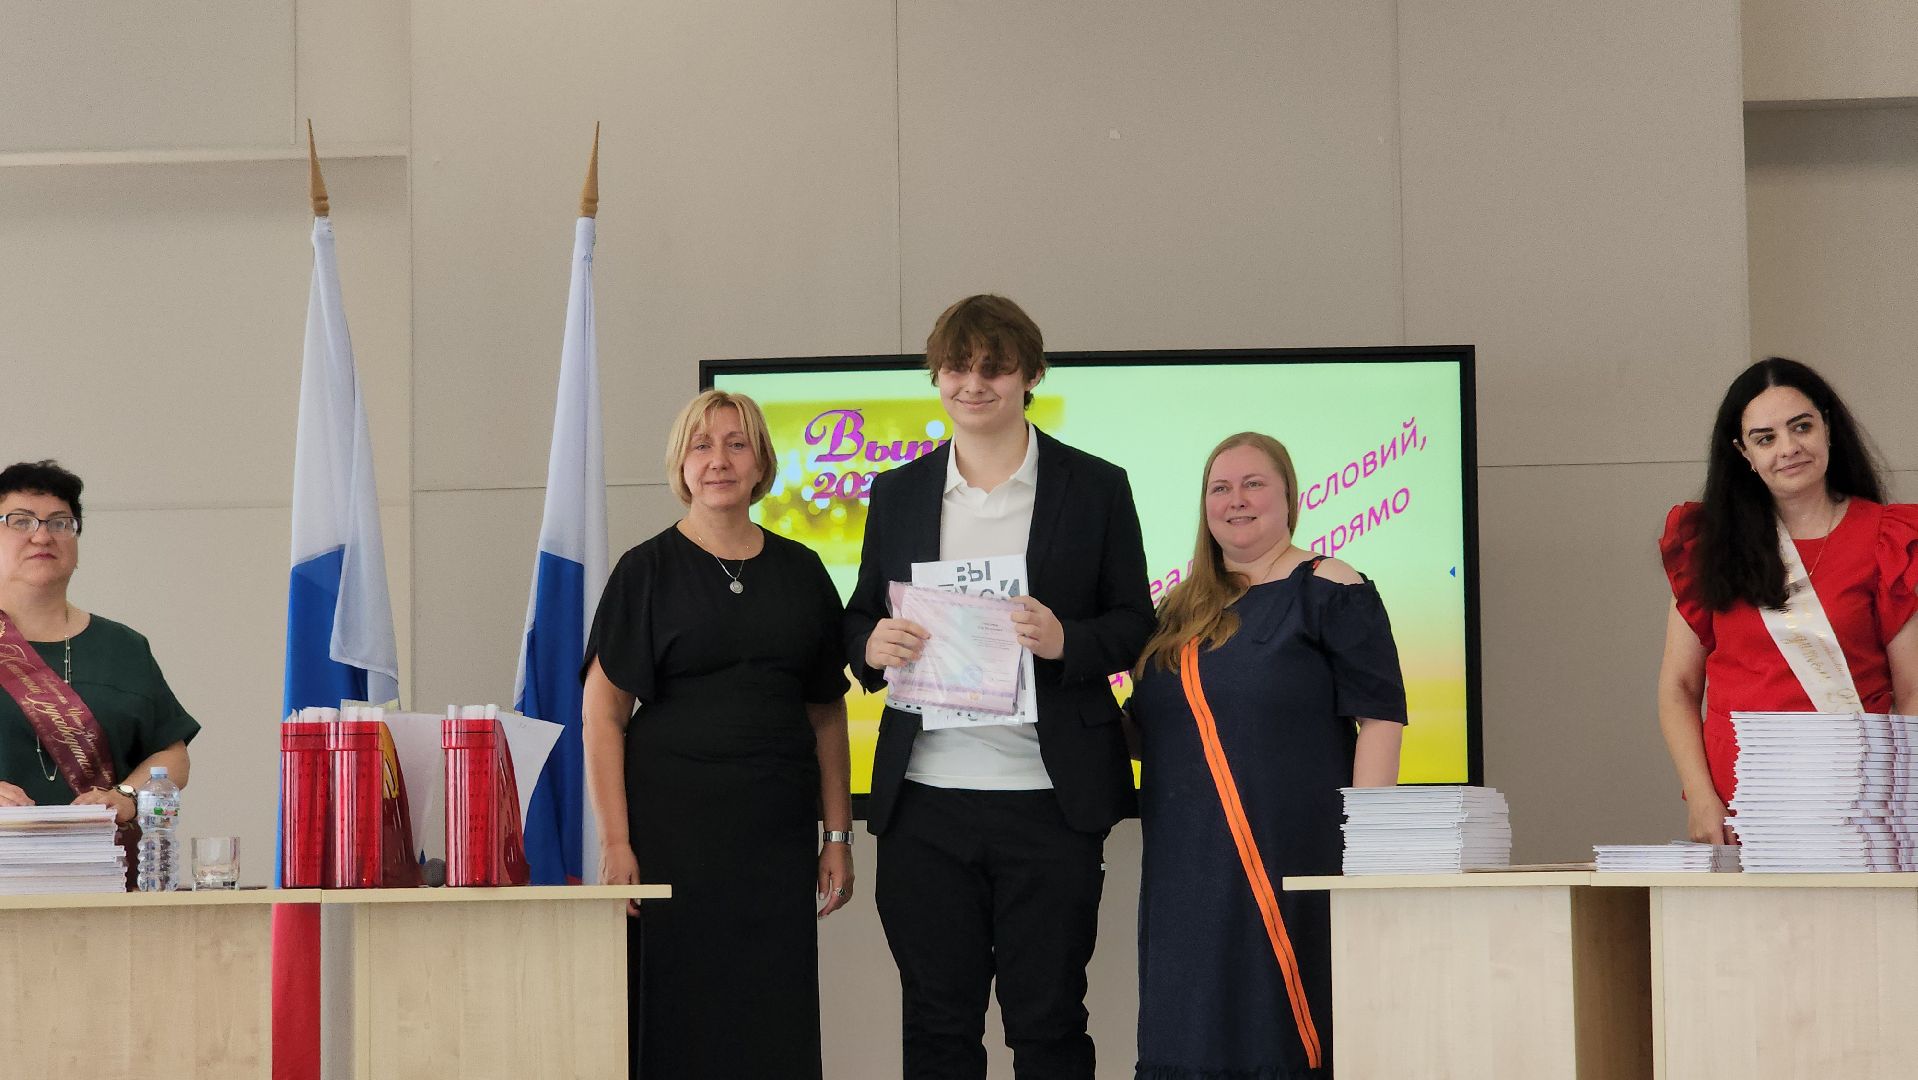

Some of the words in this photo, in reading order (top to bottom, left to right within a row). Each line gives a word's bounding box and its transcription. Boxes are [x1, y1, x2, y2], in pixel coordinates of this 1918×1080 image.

[804, 408, 949, 462] Вып
[811, 471, 879, 500] 202
[1310, 487, 1410, 559] прямо
